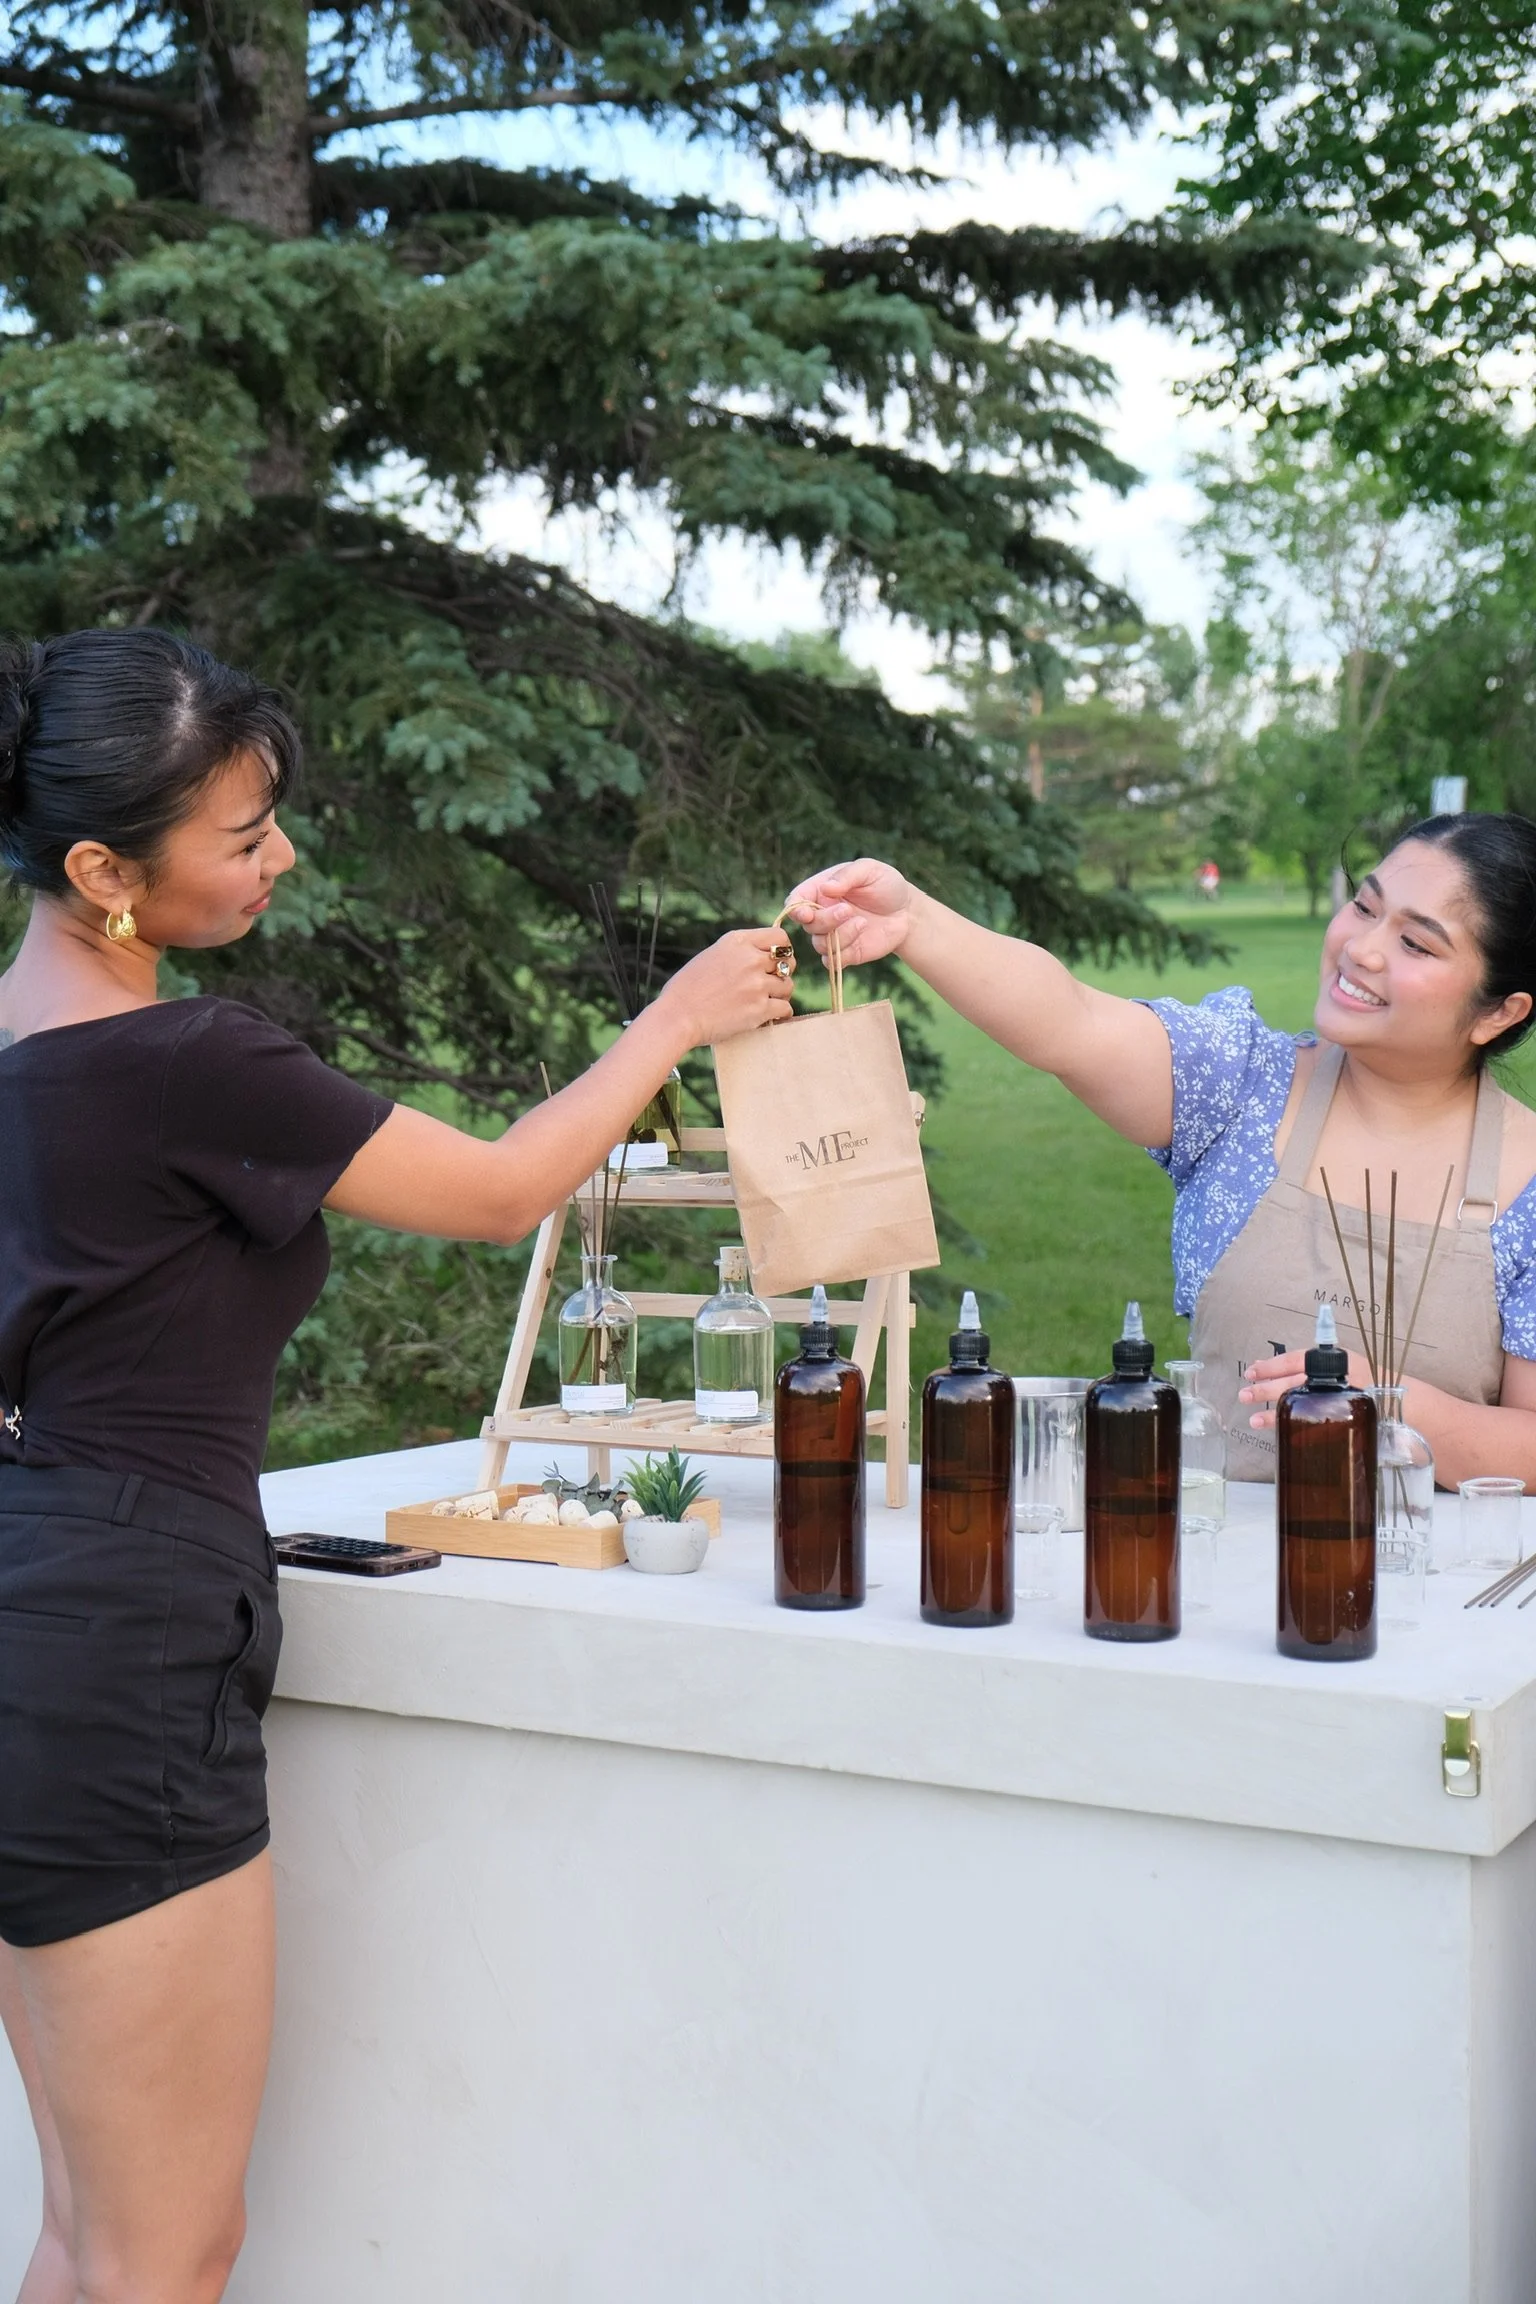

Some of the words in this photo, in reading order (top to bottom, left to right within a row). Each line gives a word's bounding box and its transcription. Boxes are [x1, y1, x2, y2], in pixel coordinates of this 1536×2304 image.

[785, 1153, 800, 1164] THE
[796, 1131, 856, 1170] ME
[840, 1137, 869, 1151] PROJECT
[1314, 1289, 1394, 1319] MARGO
[1230, 1427, 1278, 1453] experienc
